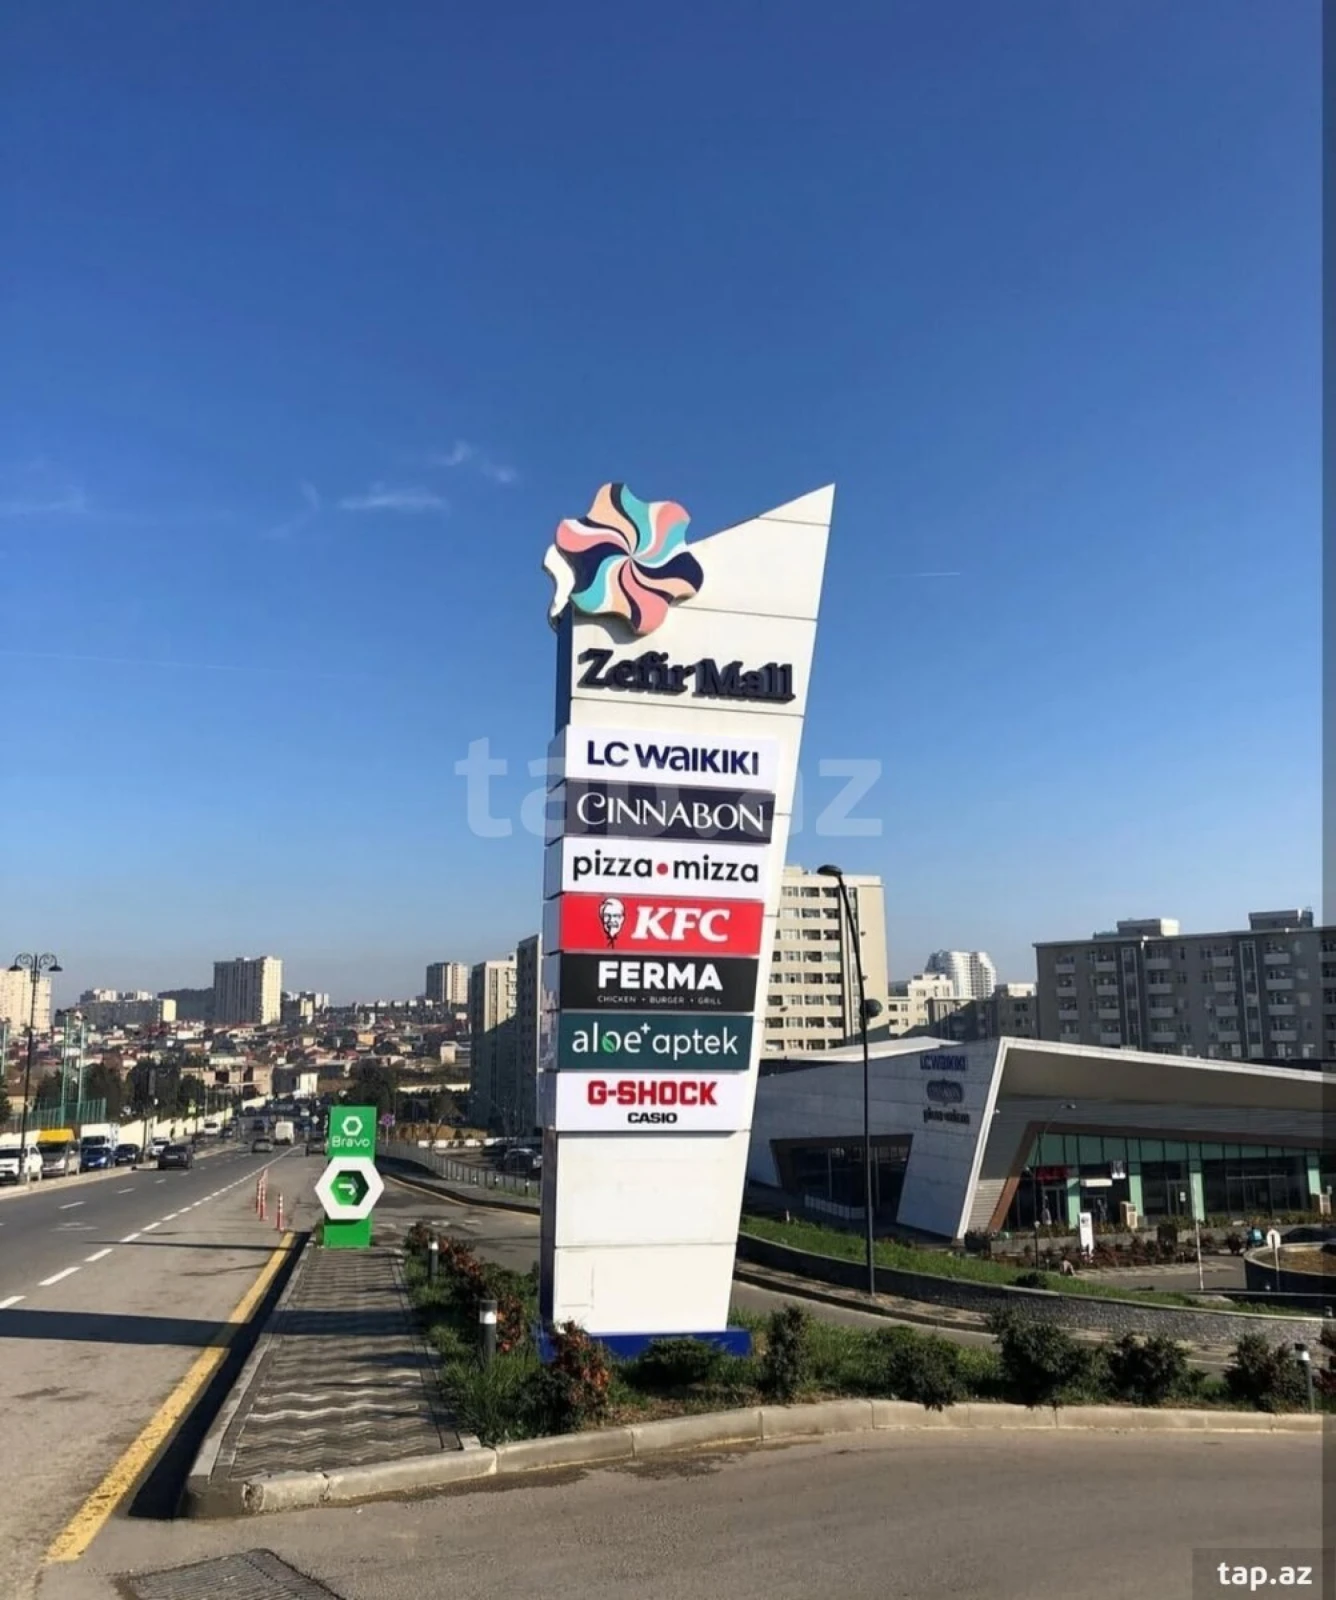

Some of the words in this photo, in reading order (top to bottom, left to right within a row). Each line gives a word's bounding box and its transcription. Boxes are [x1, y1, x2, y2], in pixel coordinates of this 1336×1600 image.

[577, 648, 696, 692] Zefir
[692, 658, 796, 704] Mall
[586, 740, 630, 767] LC
[576, 791, 764, 832] CINNABON
[631, 905, 730, 942] KFC
[597, 961, 723, 991] FERMA
[652, 1027, 738, 1060] aptek
[587, 1080, 718, 1106] G-SHOCK
[627, 1112, 678, 1124] CASIO
[332, 1136, 370, 1148] Bravo
